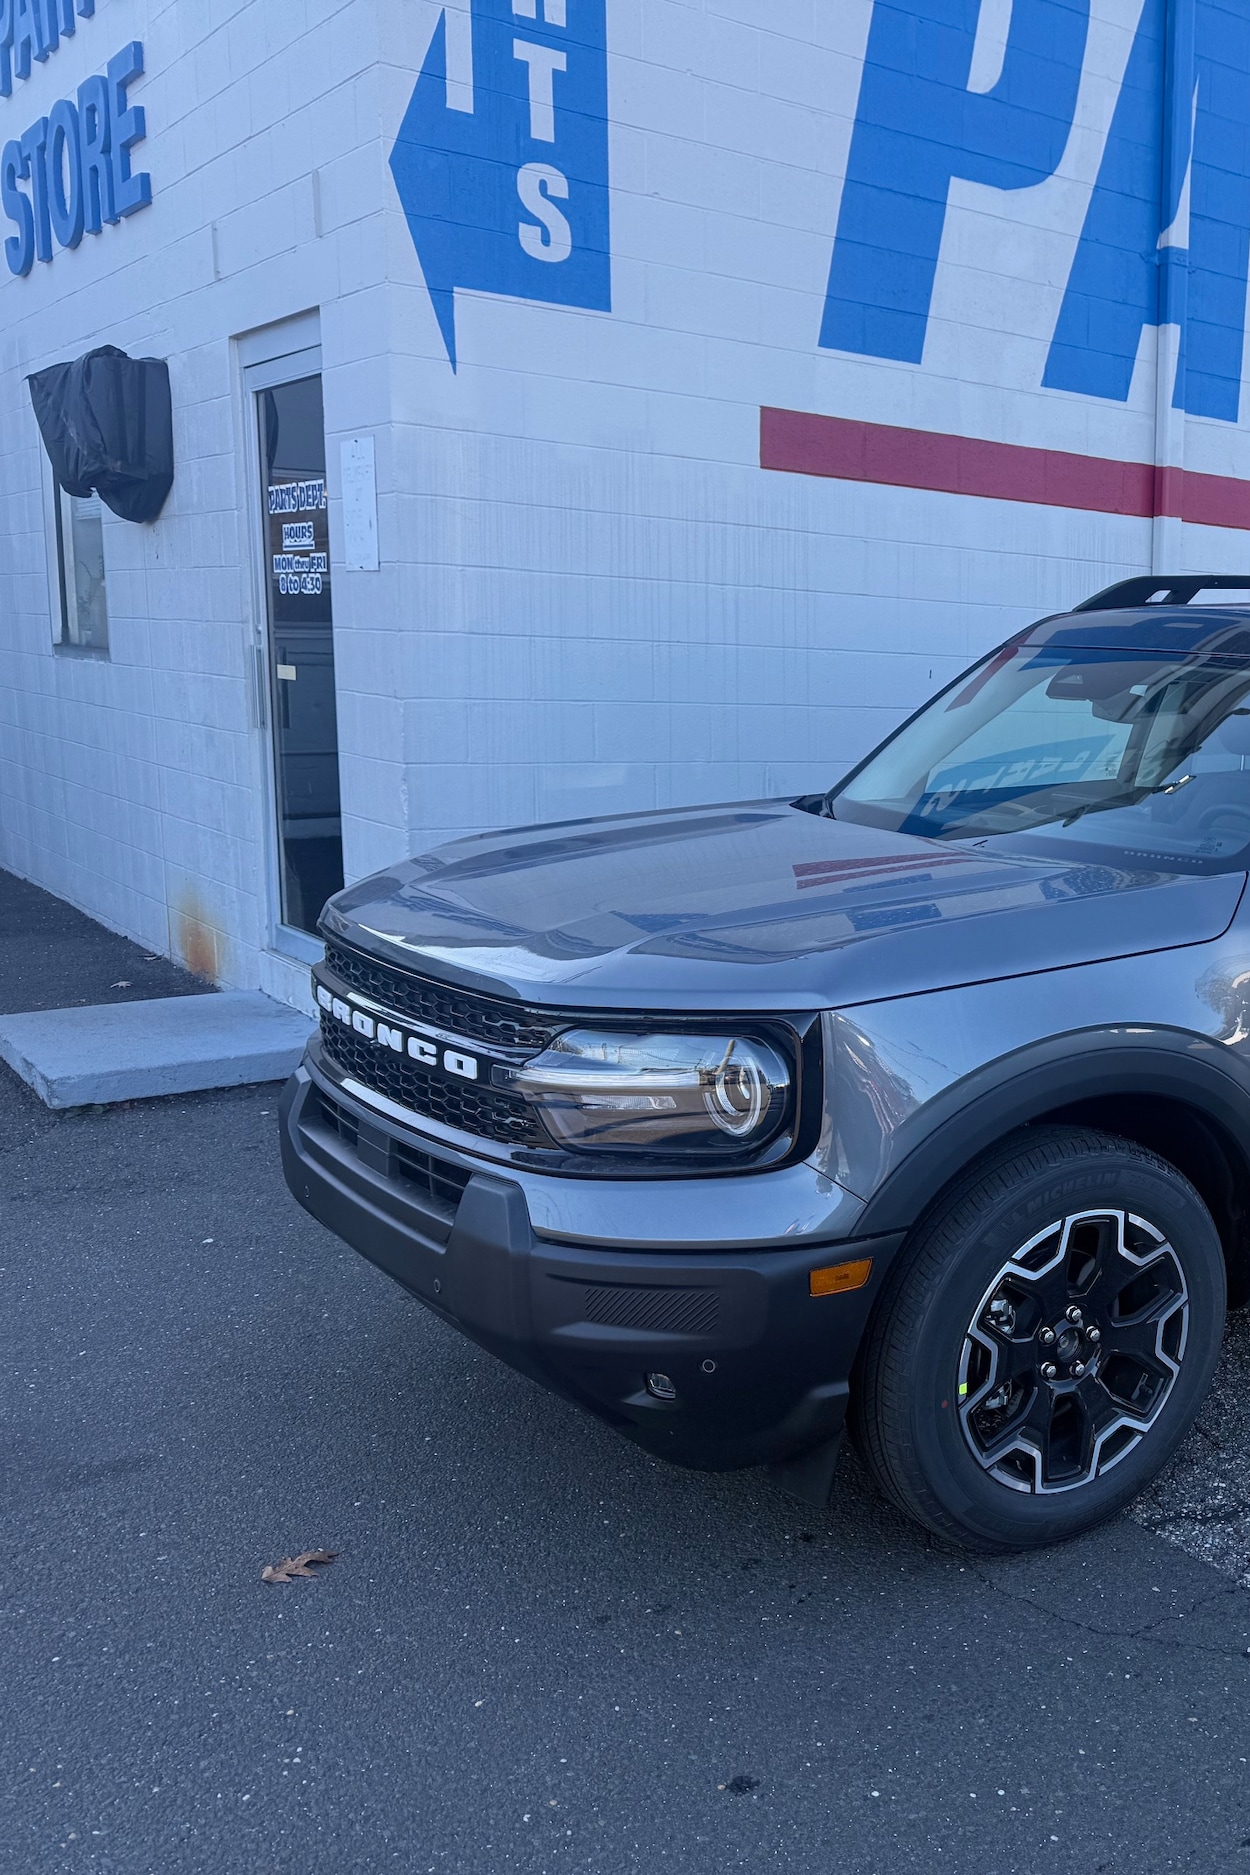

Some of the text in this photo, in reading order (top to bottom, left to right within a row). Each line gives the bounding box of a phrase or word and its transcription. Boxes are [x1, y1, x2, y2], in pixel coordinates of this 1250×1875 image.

[1, 41, 152, 277] STORE
[268, 482, 298, 514] PARTS
[282, 522, 314, 542] HOURS
[273, 554, 294, 573] MON
[310, 553, 327, 572] FRI
[279, 573, 322, 594] 8 to 4:30
[316, 985, 478, 1080] BRONCO
